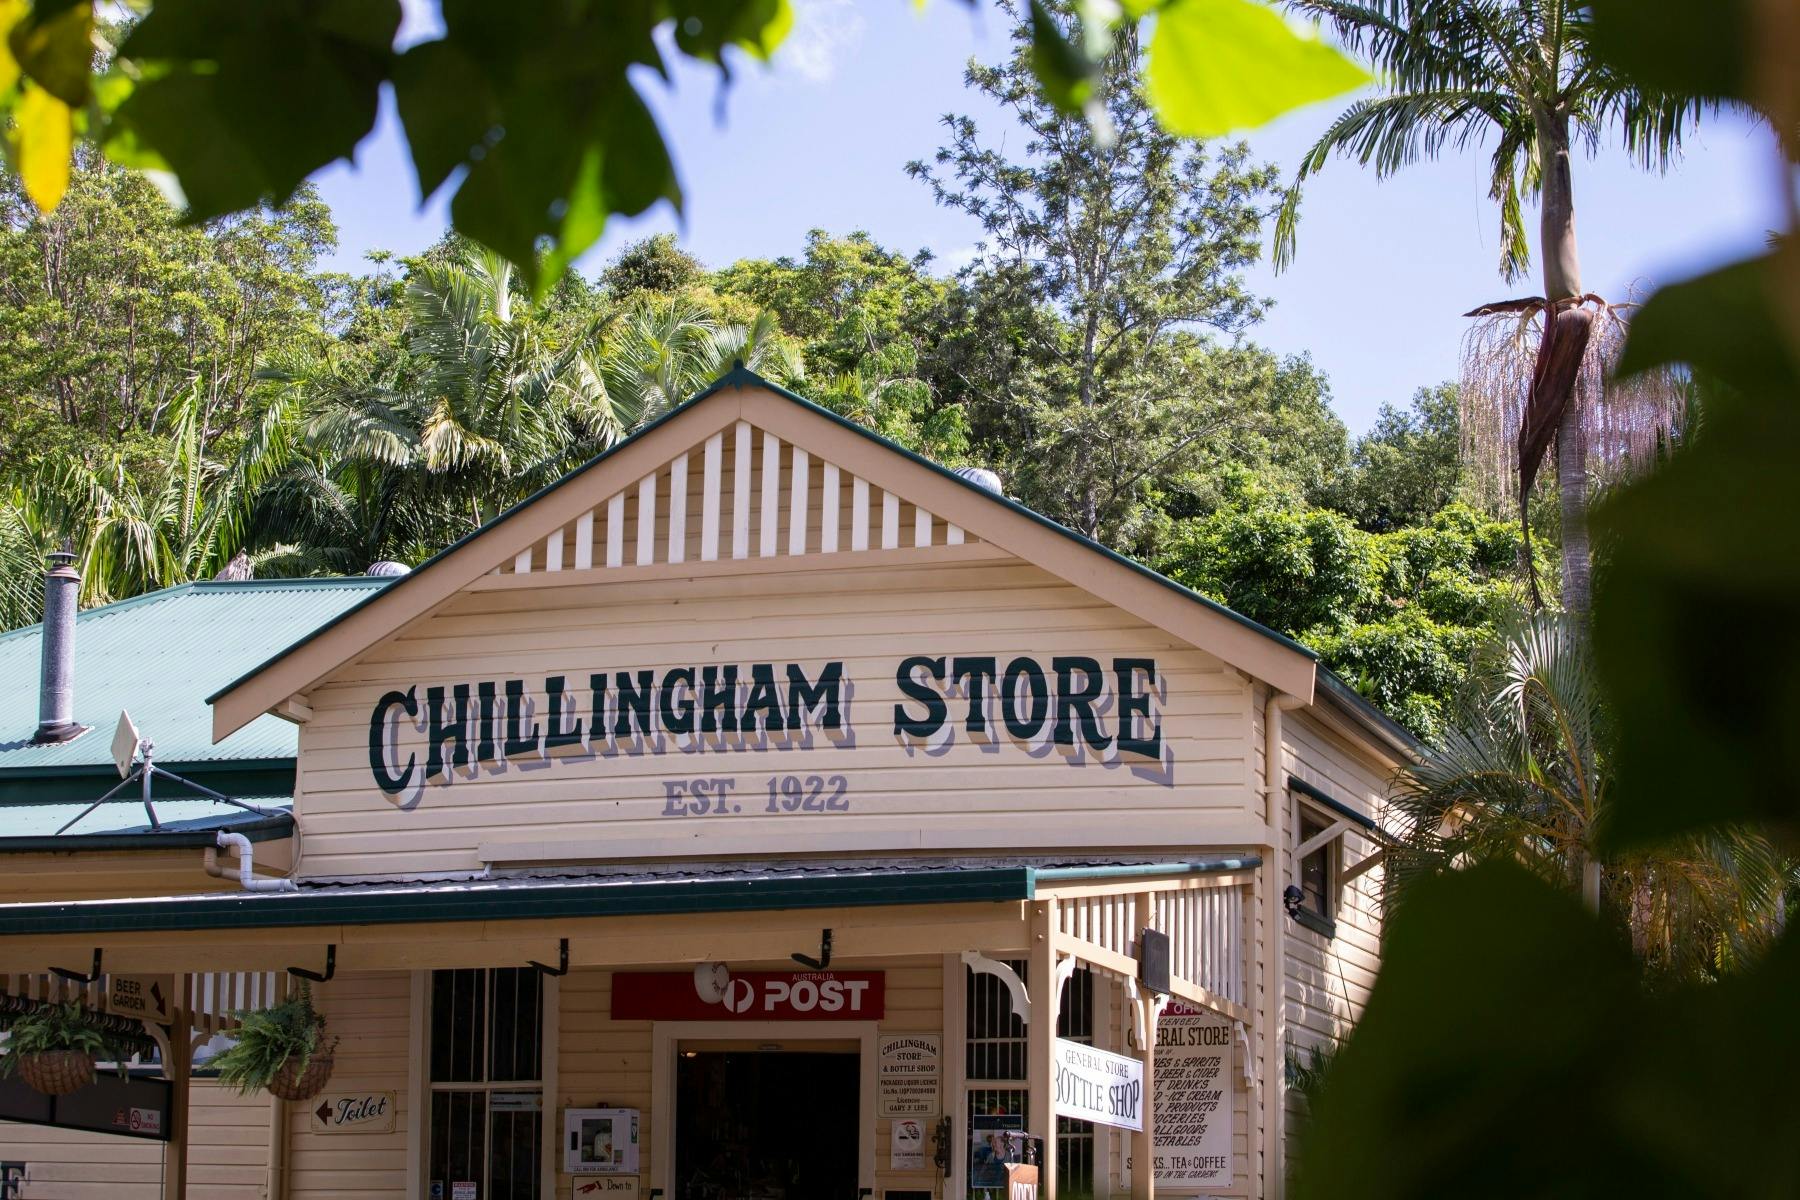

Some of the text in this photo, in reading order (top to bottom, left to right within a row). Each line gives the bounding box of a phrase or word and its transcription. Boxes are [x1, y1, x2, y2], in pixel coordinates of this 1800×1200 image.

[370, 657, 1165, 800] CHILLINGHAM STORE
[662, 775, 850, 816] EST. 1922
[792, 973, 834, 981] AUSTRALIA
[116, 978, 141, 995] BEER
[113, 993, 146, 1010] GARDEN
[765, 980, 869, 1012] POST
[1188, 1026, 1229, 1046] STORE
[882, 1039, 937, 1056] CHILLINGHAM
[897, 1052, 922, 1061] STORE
[1065, 1049, 1103, 1072] GENERAL
[1105, 1060, 1129, 1079] STORE
[1183, 1057, 1222, 1067] SPIRITS
[1160, 1068, 1186, 1078] BEER
[1193, 1068, 1220, 1078] CIDER
[1167, 1079, 1209, 1090] DRINKS
[1108, 1079, 1140, 1120] SHOP
[1187, 1091, 1223, 1101] CREAM
[335, 1096, 387, 1125] Toilet
[1166, 1102, 1219, 1112] PRODUCTS
[1171, 1156, 1187, 1169] TEA
[1193, 1156, 1227, 1169] COFFEE
[607, 1179, 632, 1191] Down to
